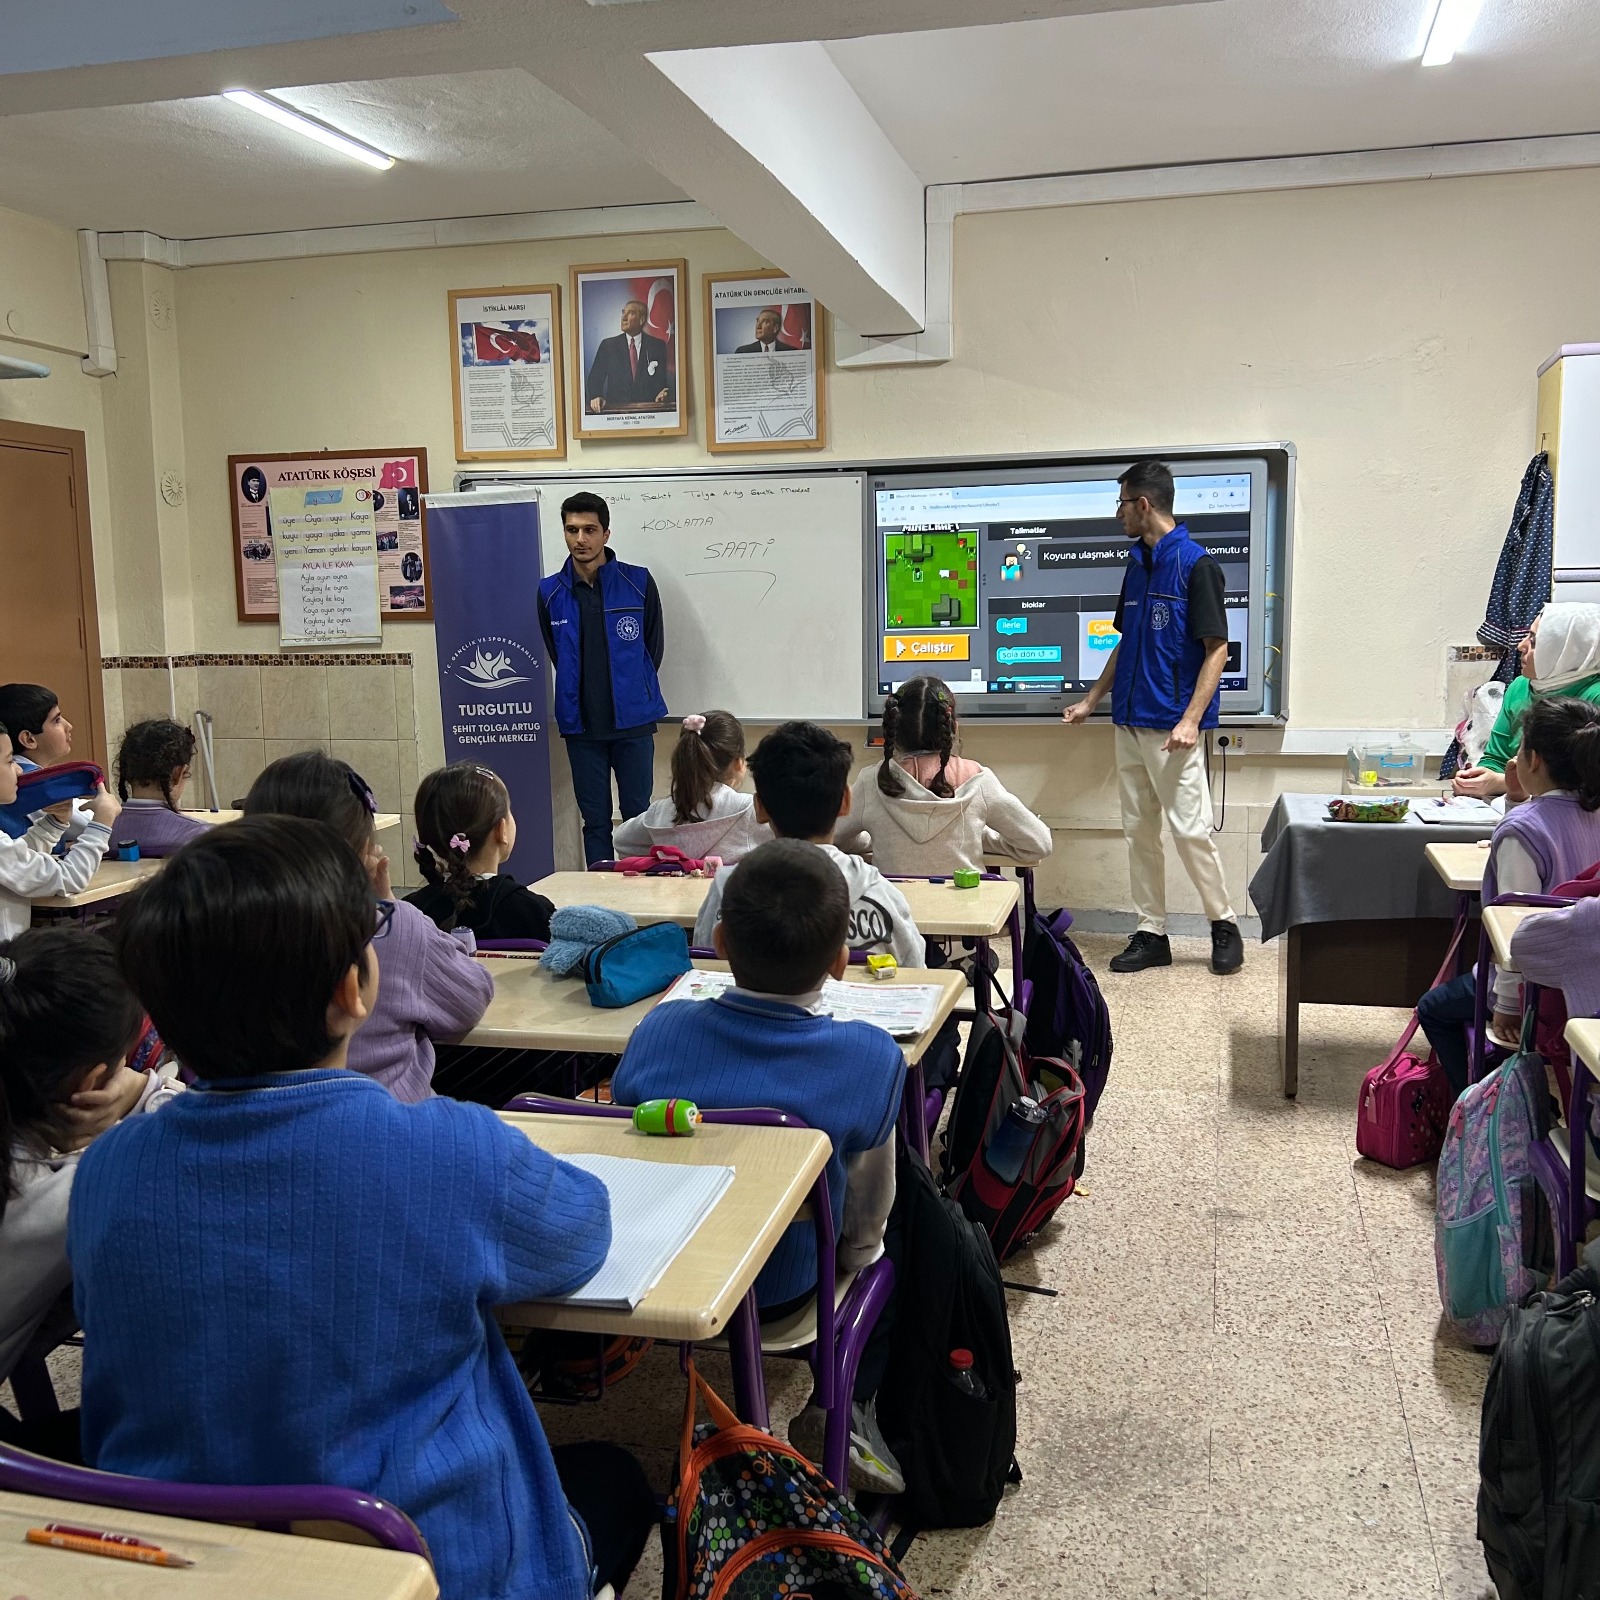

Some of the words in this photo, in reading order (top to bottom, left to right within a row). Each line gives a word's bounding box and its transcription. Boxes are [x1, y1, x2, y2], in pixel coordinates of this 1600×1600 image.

[278, 468, 330, 482] ATATÜRK
[334, 466, 376, 480] KÖŞESİ
[283, 516, 296, 527] üye
[305, 514, 321, 525] Oya
[351, 512, 369, 523] Kaya
[641, 517, 714, 533] KODLAMA
[283, 533, 299, 542] kuyu
[329, 529, 345, 540] yaka
[351, 530, 370, 539] yama
[1010, 526, 1047, 535] Talimatlar
[303, 545, 326, 554] Yaman
[329, 544, 346, 555] yelek
[1024, 550, 1032, 559] 2
[1043, 551, 1077, 562] Koyuna
[1079, 549, 1115, 561] ulaşmak
[1205, 546, 1240, 555] komutu
[302, 562, 320, 570] AYLA
[335, 560, 354, 568] KAYA
[301, 573, 315, 583] Ayla
[317, 575, 331, 583] oyun
[303, 606, 318, 616] Kaya
[321, 607, 334, 615] oyun
[1093, 637, 1114, 645] ilerle
[452, 639, 477, 661] GENÇLİK
[508, 640, 540, 669] BAKANLIĞI
[910, 641, 955, 656] Çalıştır
[458, 702, 532, 716] TURGUTLU
[452, 723, 476, 735] ŞEHİT
[478, 723, 509, 733] TOLGA
[511, 723, 541, 732] ARTUG
[458, 733, 496, 745] GENÇLİK
[499, 732, 537, 743] MERKEZİ
[847, 908, 884, 940] SCO
